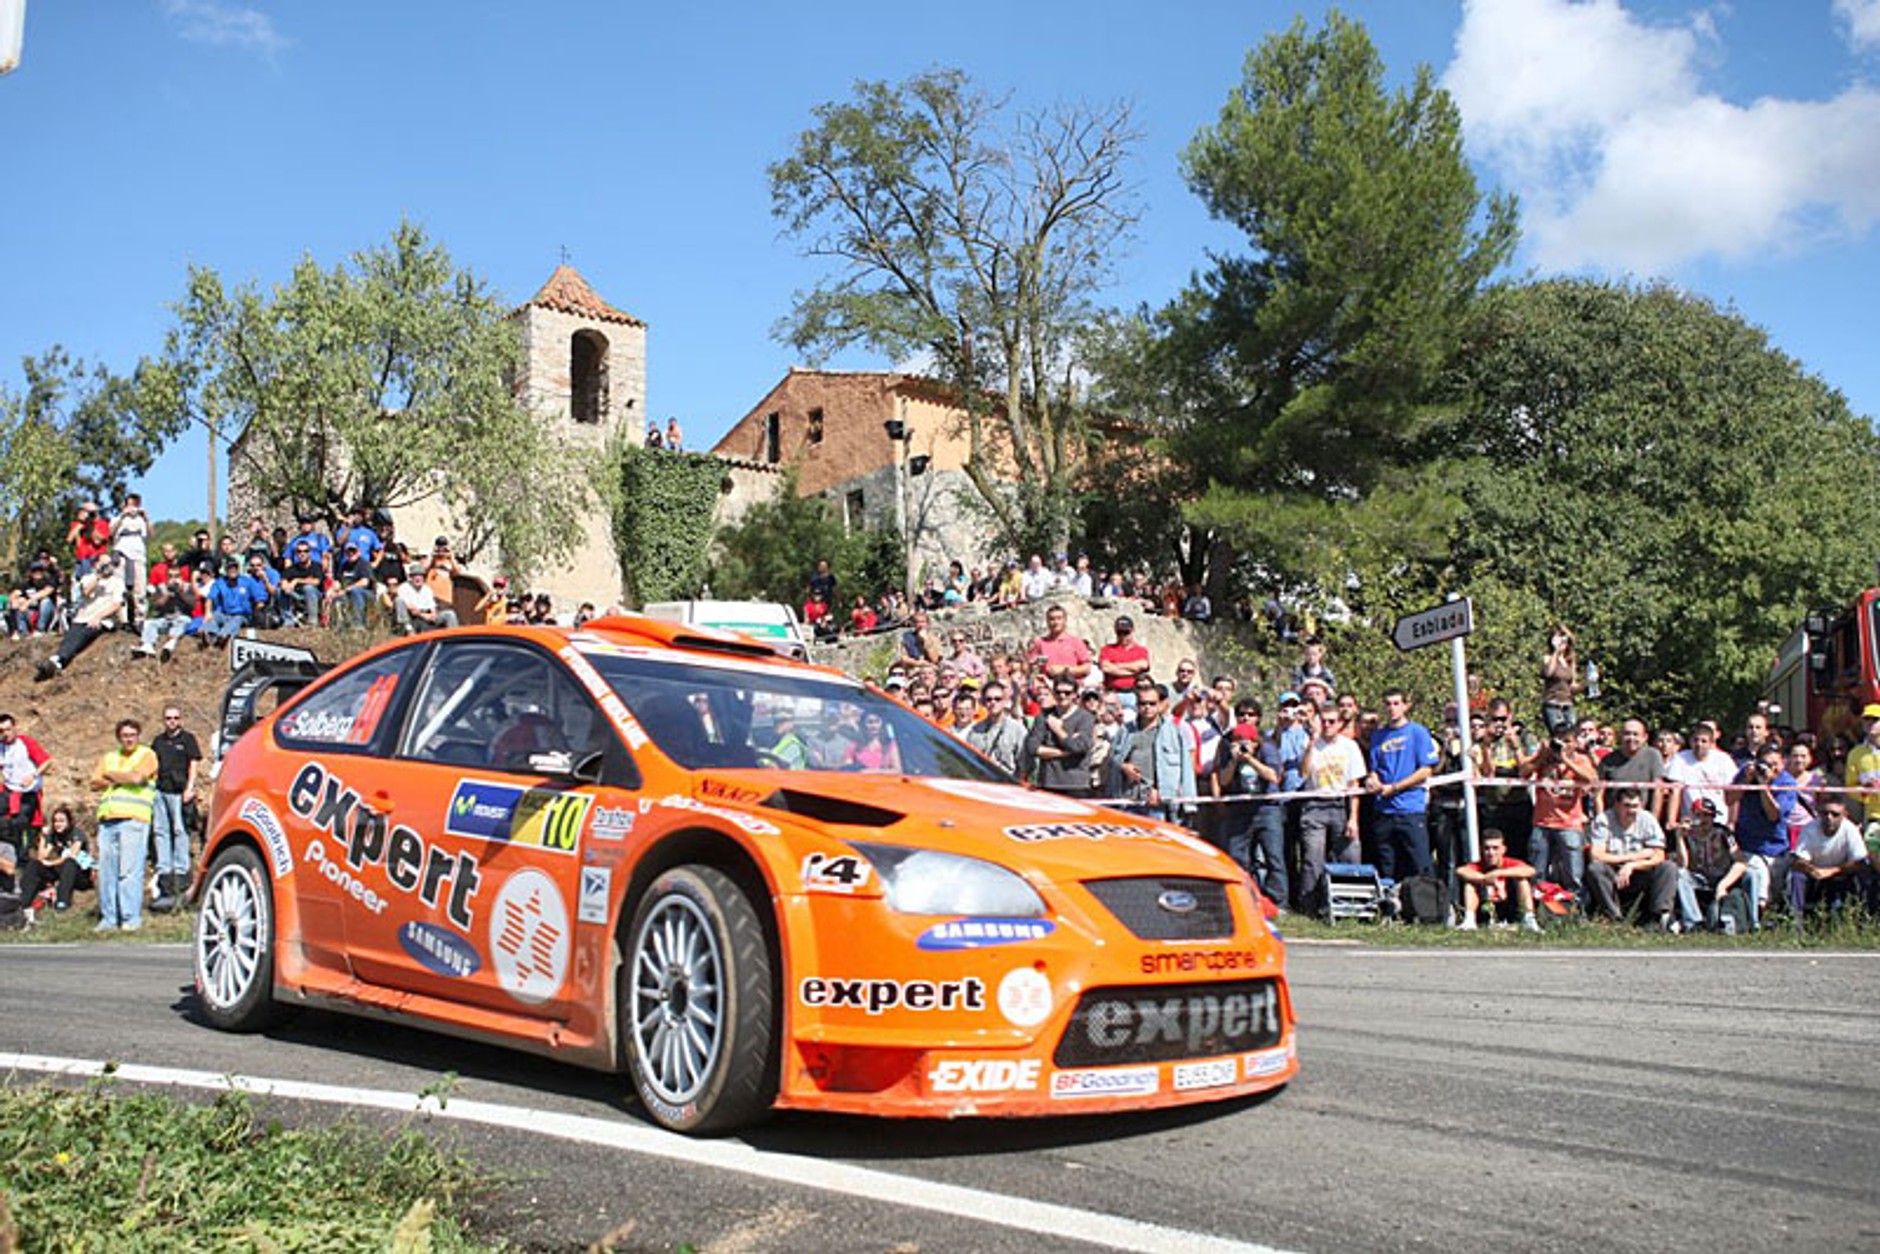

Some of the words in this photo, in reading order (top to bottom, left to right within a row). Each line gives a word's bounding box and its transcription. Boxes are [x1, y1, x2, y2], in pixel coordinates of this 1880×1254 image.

[288, 762, 481, 931] expert
[541, 793, 587, 850] 10
[303, 840, 389, 915] Pioneer
[405, 919, 472, 977] SAMSUNG
[931, 923, 1046, 939] SAMSUNG
[802, 979, 984, 1012] expert
[1086, 984, 1279, 1051] expert
[932, 1058, 1042, 1092] EXIDE
